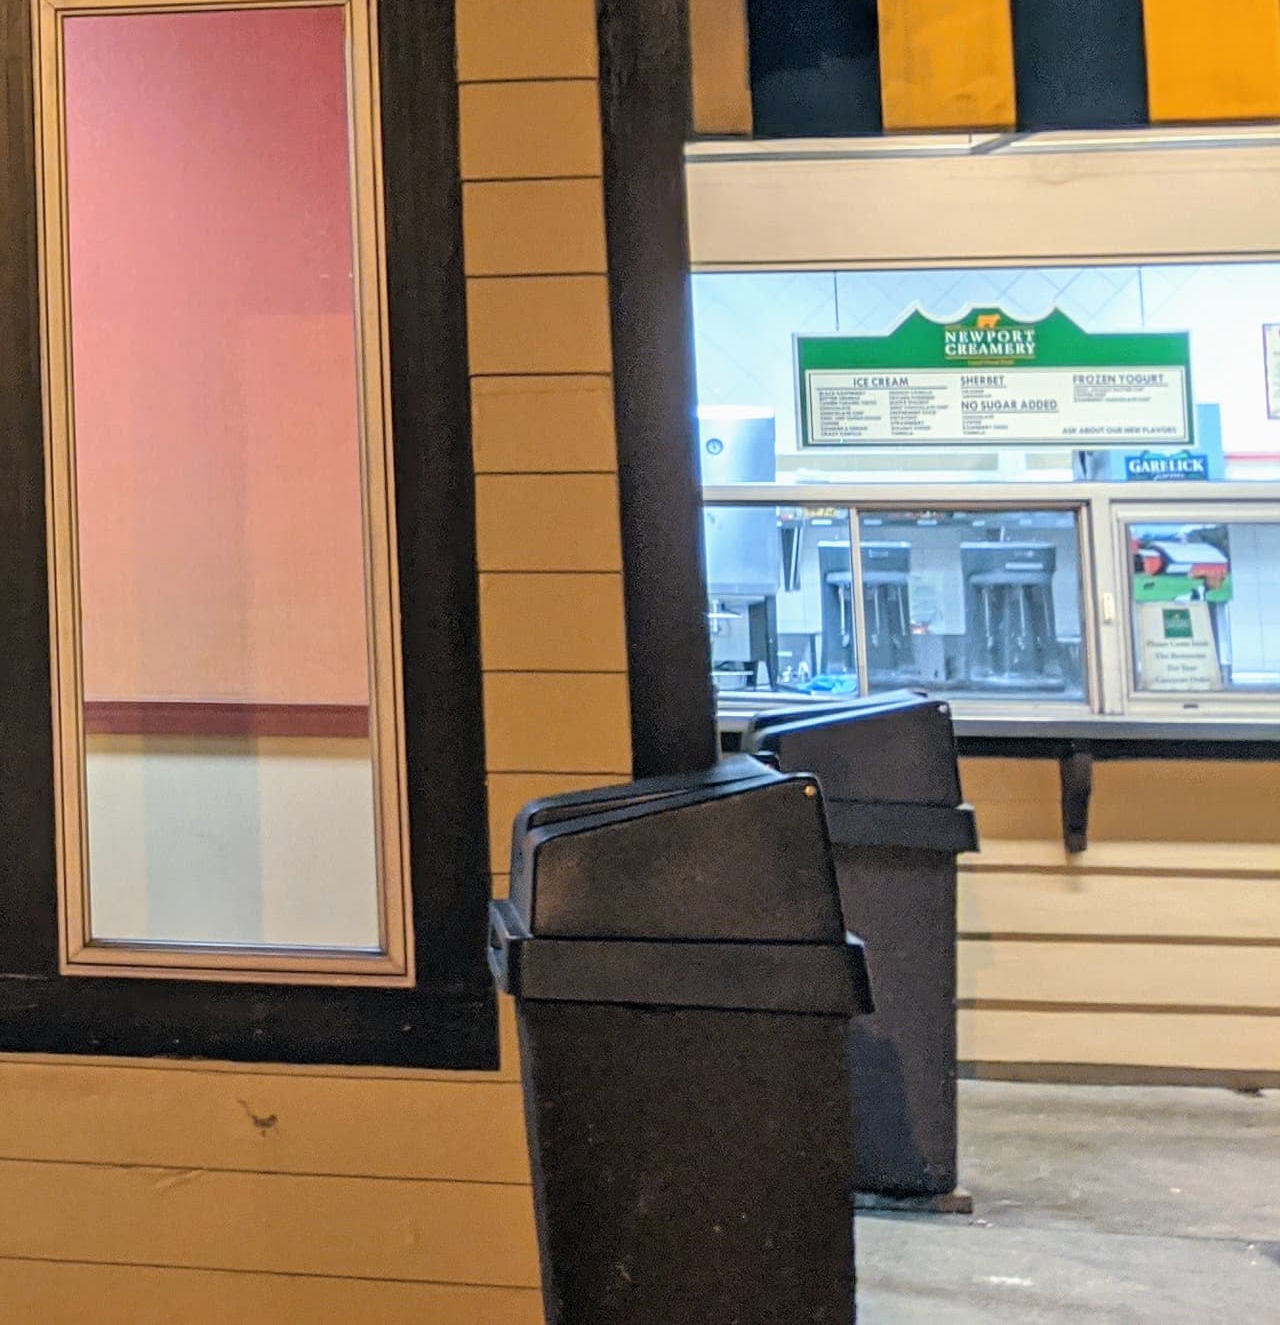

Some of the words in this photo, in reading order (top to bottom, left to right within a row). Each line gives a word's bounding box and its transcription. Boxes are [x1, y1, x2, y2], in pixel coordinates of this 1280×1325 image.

[944, 329, 1036, 343] NEWPORT
[944, 342, 1036, 356] CREAMERY
[852, 377, 869, 388] ICE
[871, 376, 910, 388] CREAM
[960, 375, 1005, 386] SHERBET
[1072, 373, 1117, 386] FROZEN
[1119, 373, 1165, 385] YOGURT
[961, 400, 979, 411] NO
[981, 399, 1018, 410] SUGAR
[1020, 398, 1058, 410] ADDED
[1128, 458, 1205, 473] GARELICK
